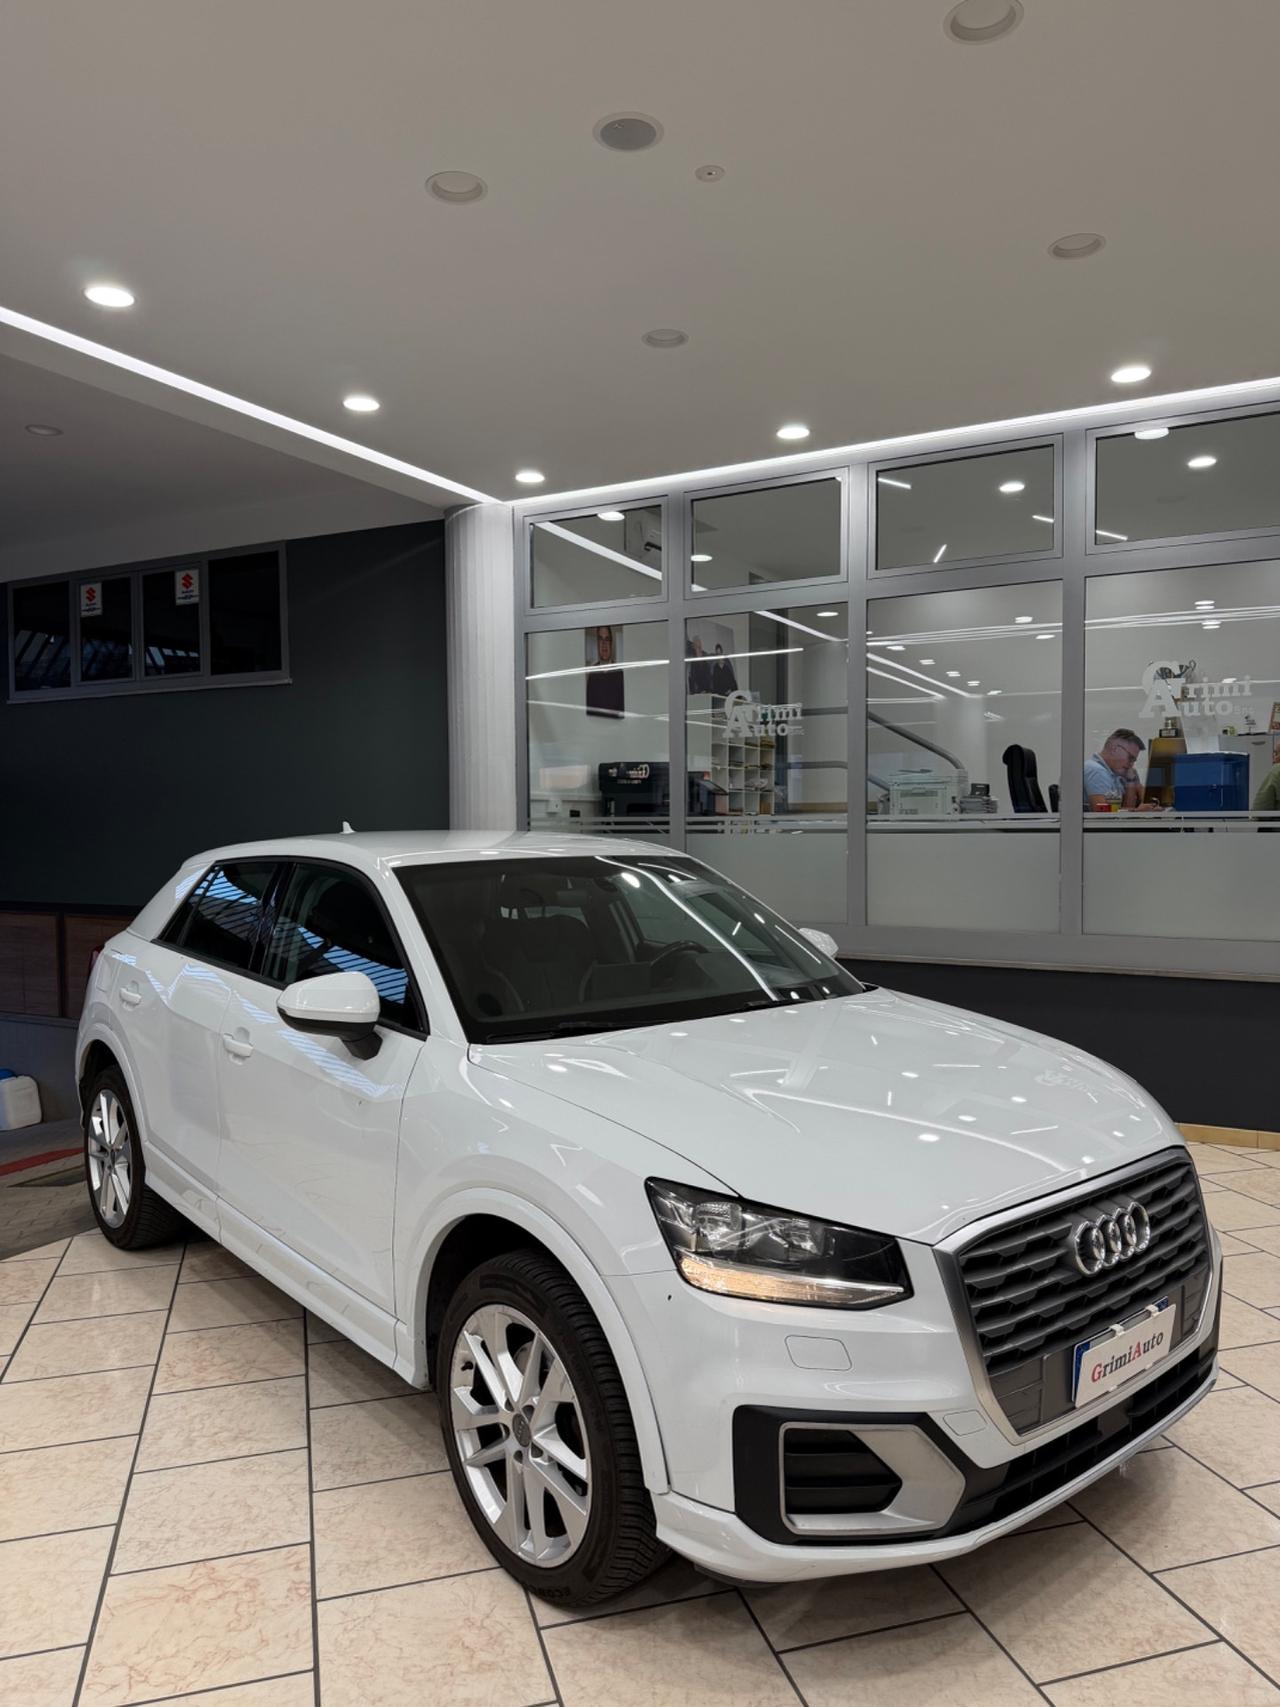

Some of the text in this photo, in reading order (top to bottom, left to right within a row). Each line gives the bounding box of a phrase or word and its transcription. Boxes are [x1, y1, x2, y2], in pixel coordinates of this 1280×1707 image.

[1139, 678, 1233, 718] Auto
[722, 705, 789, 738] Auto
[1091, 1332, 1164, 1383] GrimiAuto
